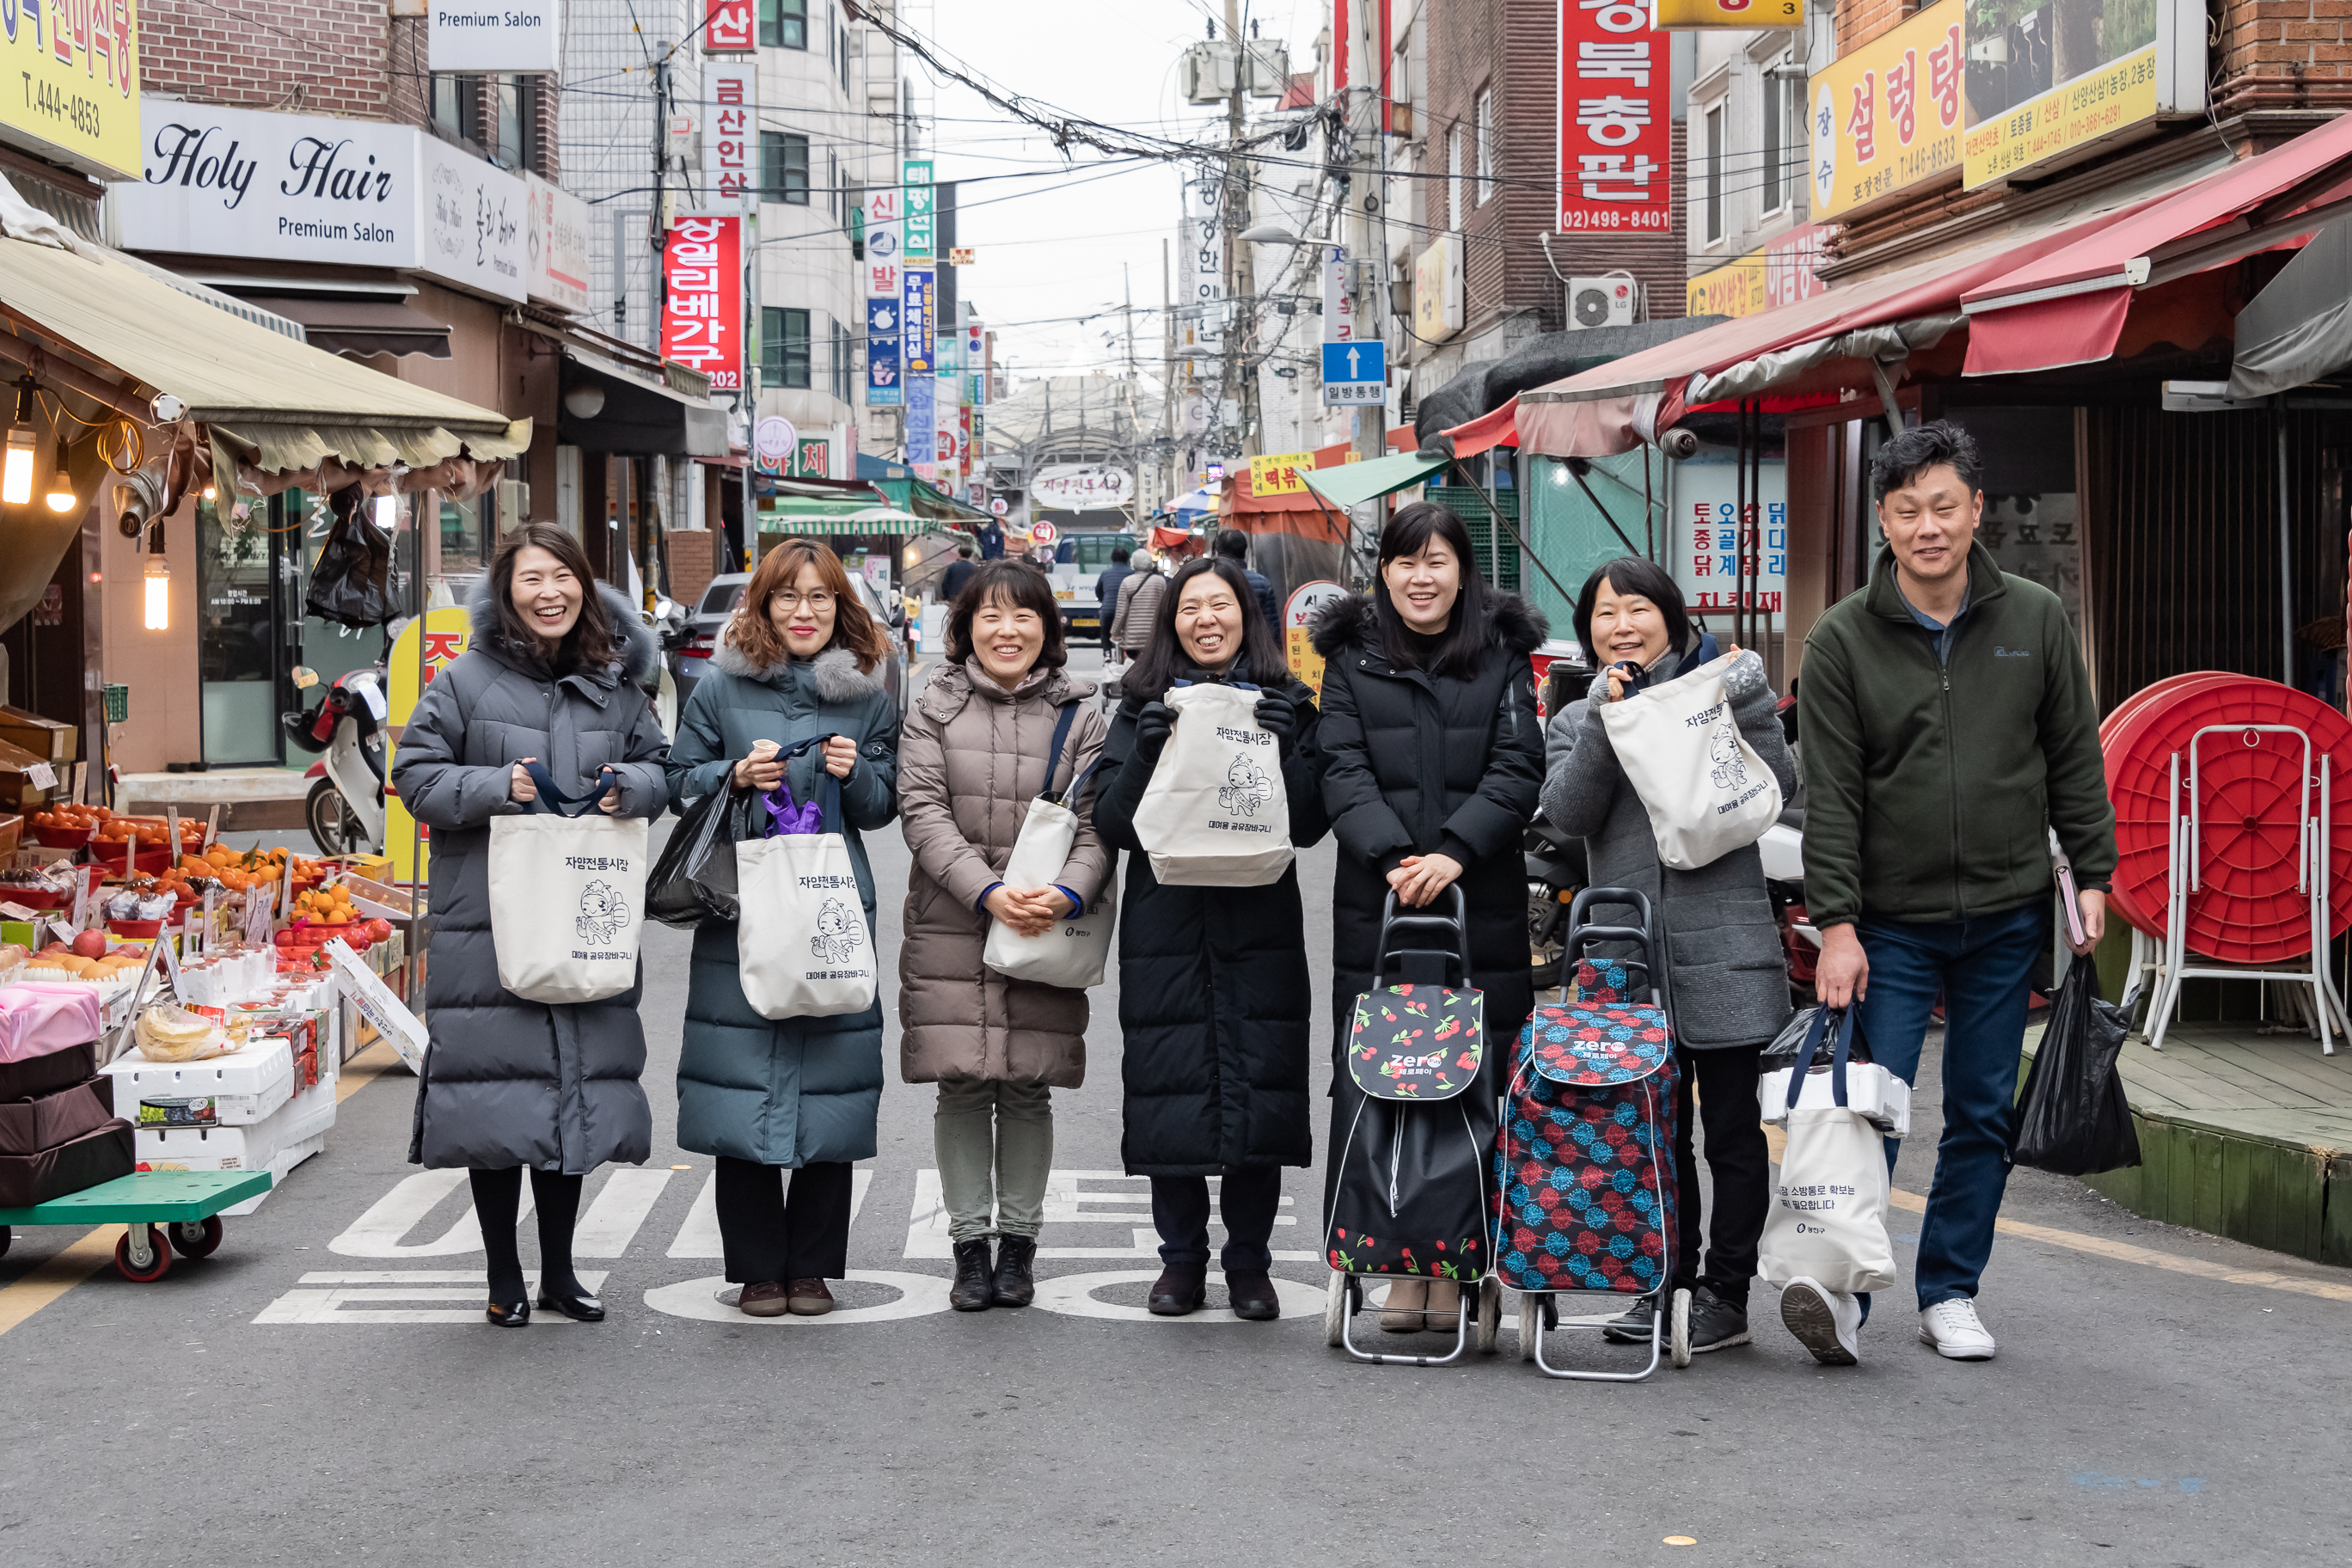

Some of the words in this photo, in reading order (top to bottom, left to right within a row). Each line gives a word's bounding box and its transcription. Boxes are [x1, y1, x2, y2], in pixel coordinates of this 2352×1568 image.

[439, 12, 499, 28] Premium
[505, 12, 542, 28] Salon
[22, 70, 100, 138] T.444-4853
[1845, 23, 1963, 165] 설렁탕
[1965, 126, 2000, 159] 자연산약초
[2010, 111, 2032, 138] 토종꿀
[2044, 97, 2061, 124] 산삼
[2000, 149, 2012, 170] 산삼
[2027, 128, 2061, 157] T.444-1745
[2069, 104, 2122, 139] 010-3661-6291
[1817, 107, 1833, 189] 장수
[144, 123, 258, 210] Holy
[281, 136, 393, 204] Hair
[1853, 166, 1894, 202] 포장전문
[1900, 135, 1956, 183] T:446-8633
[279, 216, 348, 242] Premium
[353, 220, 395, 244] Salon
[1563, 211, 1669, 229] 02)498-8401
[1328, 385, 1381, 400] 일방통행
[1265, 463, 1312, 490] 떡볶
[1694, 502, 1712, 577] 토종닭
[1718, 502, 1736, 577] 오골계
[1216, 726, 1271, 746] 자양전통시장
[1718, 799, 1739, 815] 대여용
[1208, 820, 1229, 830] 대여용
[1230, 822, 1272, 834] 공유장바구니
[565, 855, 628, 872] 자양전통시장
[572, 950, 588, 960] 대여용
[590, 951, 633, 960] 공유장바구니
[805, 971, 828, 980] 대여용
[830, 969, 870, 980] 공유장바구니
[1791, 1185, 1826, 1197] 소방통로
[1829, 1185, 1855, 1196] 확보는
[1792, 1199, 1835, 1210] 필요합니다
